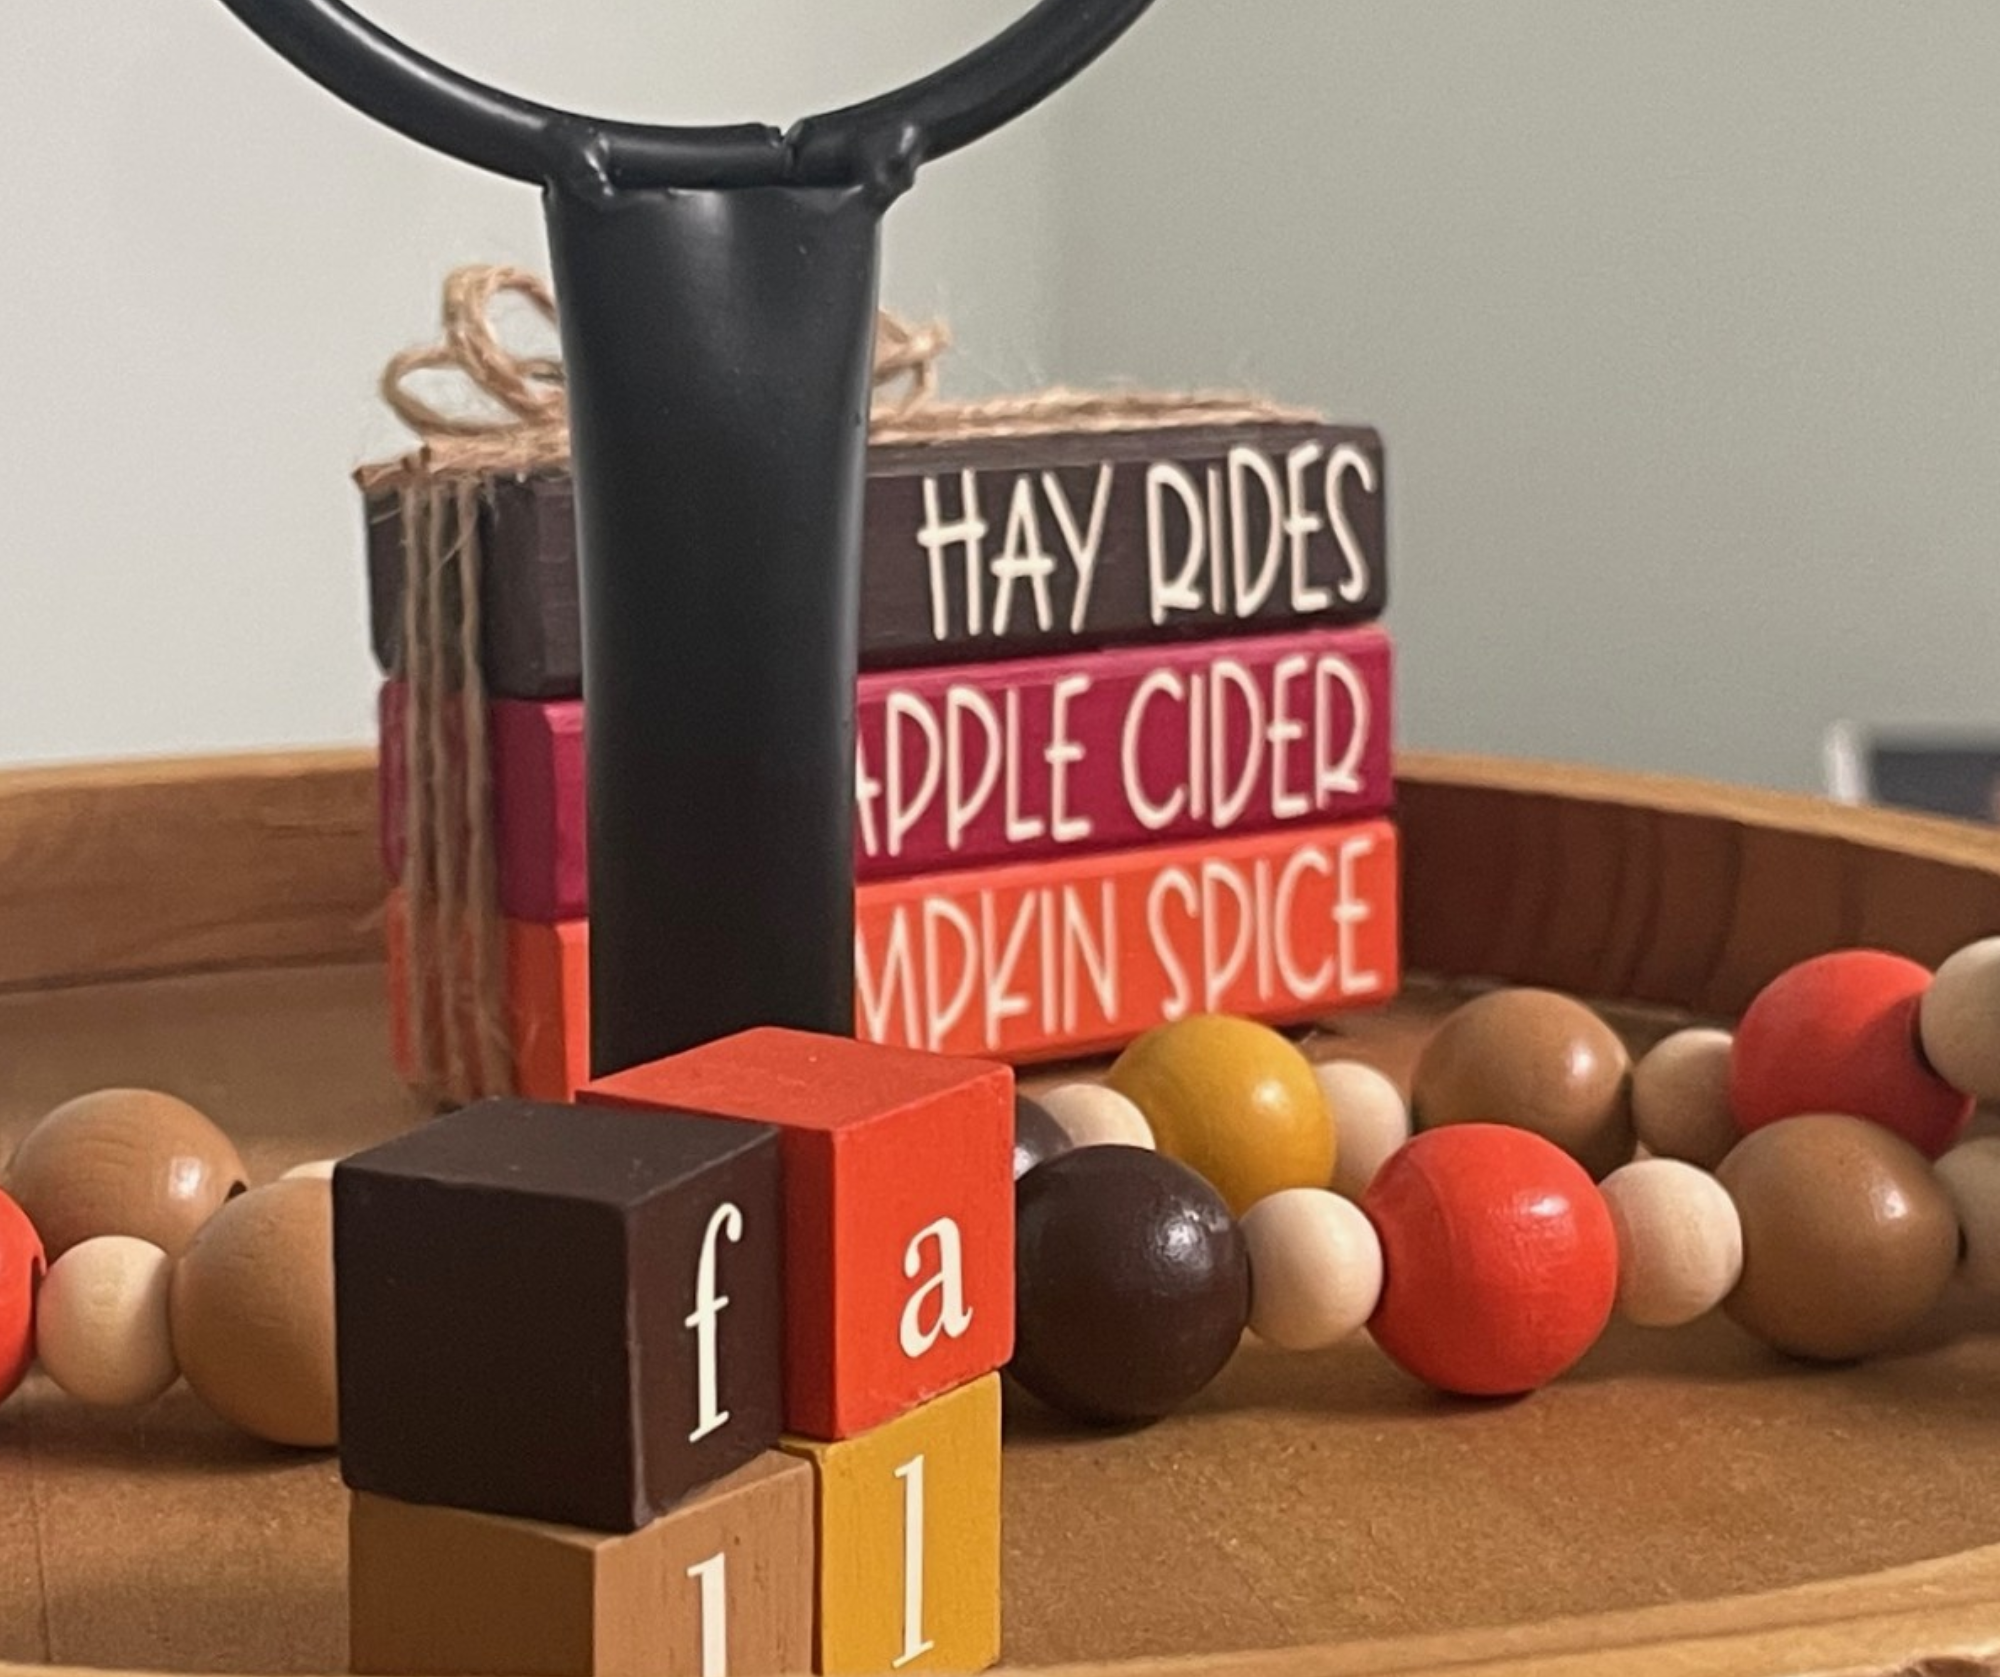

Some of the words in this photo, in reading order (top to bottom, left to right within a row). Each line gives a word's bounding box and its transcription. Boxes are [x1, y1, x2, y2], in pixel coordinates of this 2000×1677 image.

[917, 464, 1112, 640] HAY
[1146, 440, 1376, 625] RIDES
[1122, 655, 1370, 829] CIDER
[856, 880, 1118, 1052] MPKIN
[1146, 837, 1381, 1023] SPICE
[685, 1203, 743, 1442] f
[899, 1217, 973, 1357] a
